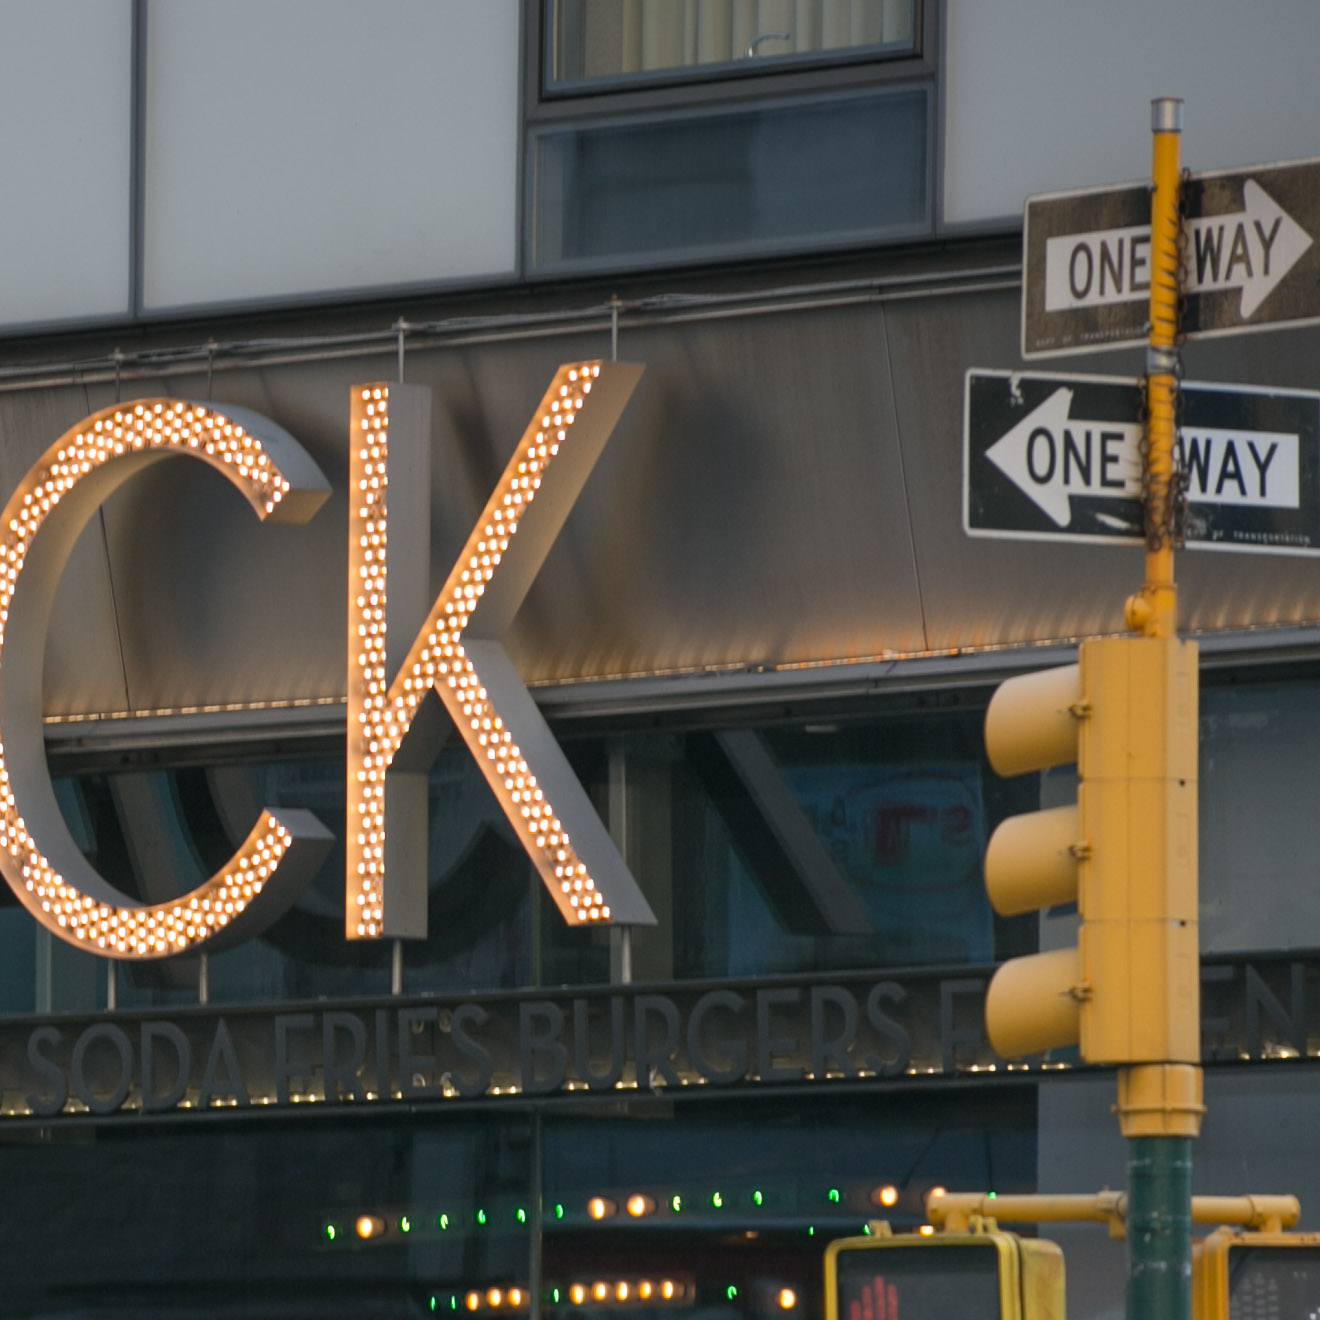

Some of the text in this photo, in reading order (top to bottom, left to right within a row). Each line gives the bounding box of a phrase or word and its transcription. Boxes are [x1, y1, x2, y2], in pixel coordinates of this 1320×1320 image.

[1070, 216, 1282, 299] ONE WAY
[1026, 426, 1278, 498] ONE WAY
[25, 1017, 250, 1118] SODA
[274, 999, 490, 1105] FRIES
[520, 982, 911, 1096] BURGERS
